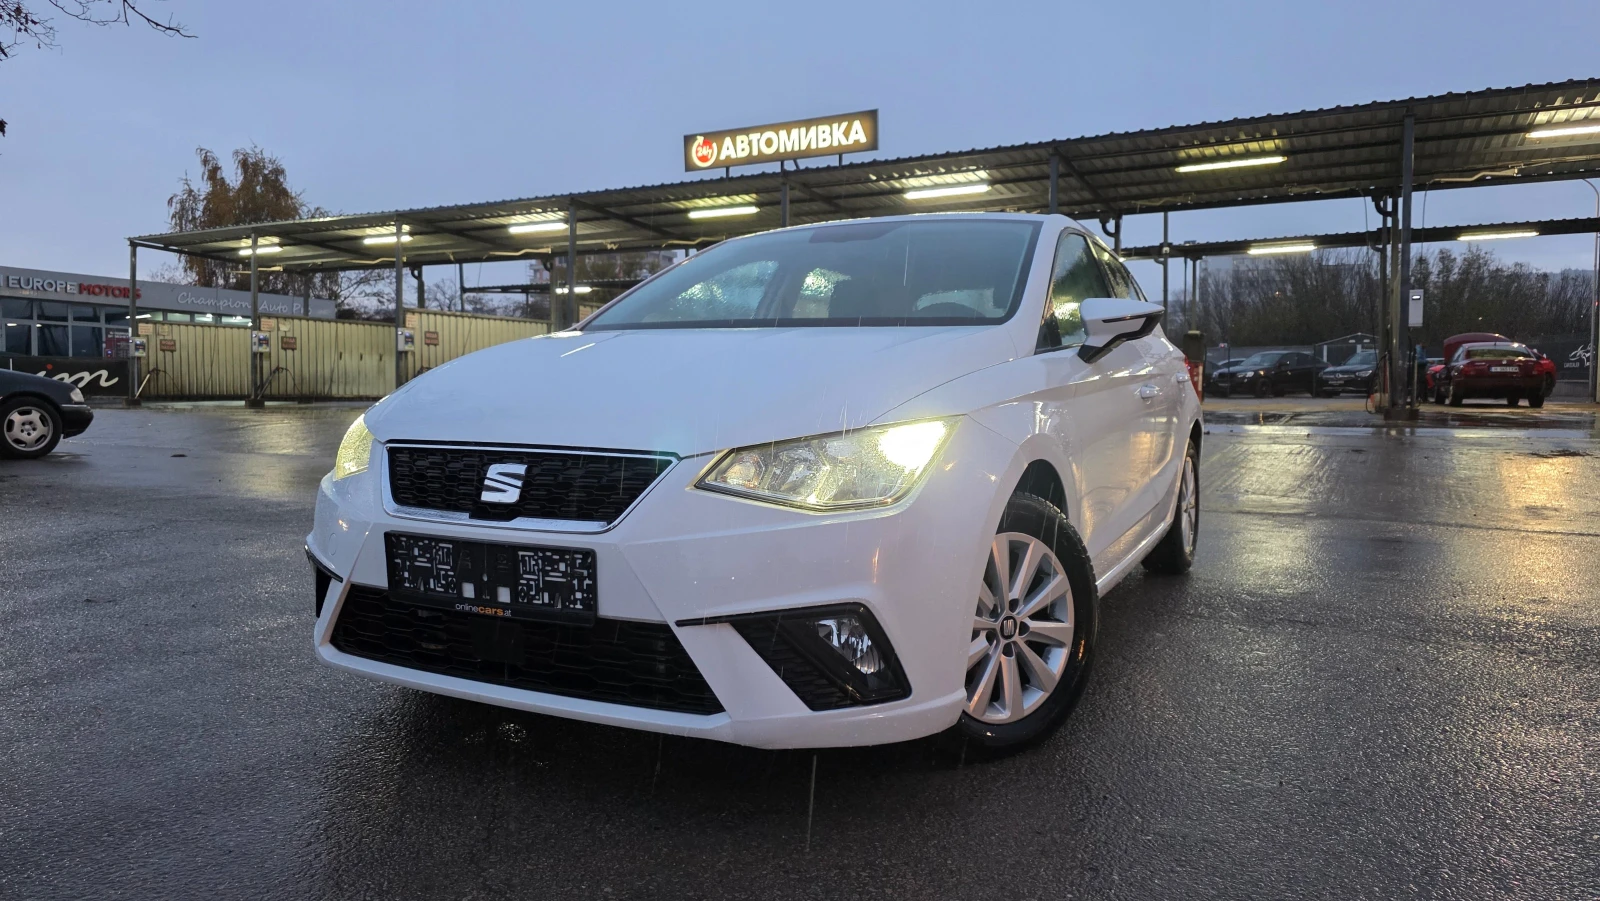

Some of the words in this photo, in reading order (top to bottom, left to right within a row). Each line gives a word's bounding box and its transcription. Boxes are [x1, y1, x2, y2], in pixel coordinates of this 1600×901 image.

[719, 119, 867, 161] АВТОМИВКА
[8, 275, 77, 294] EUROPE
[177, 291, 251, 310] Champion
[259, 301, 289, 314] Auto
[455, 603, 512, 617] onlinecars.at
